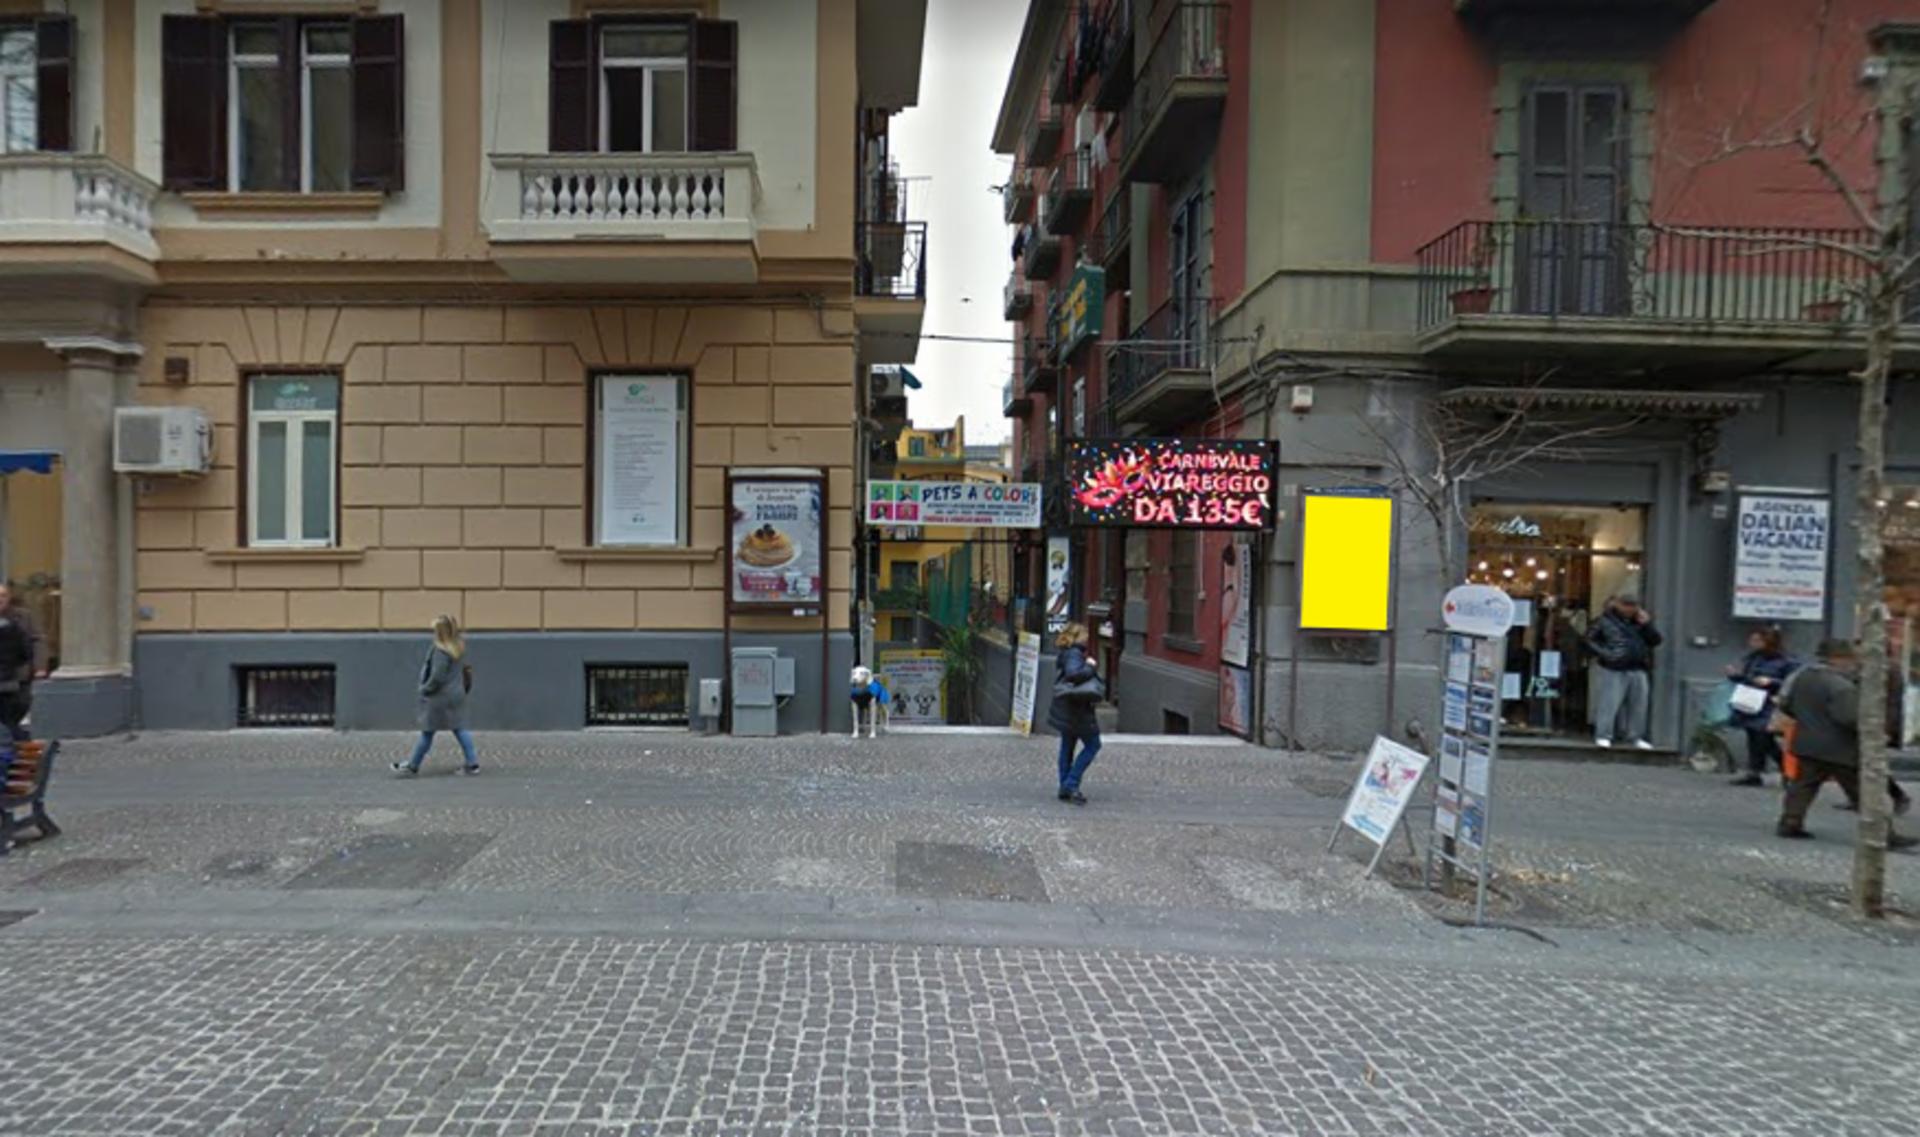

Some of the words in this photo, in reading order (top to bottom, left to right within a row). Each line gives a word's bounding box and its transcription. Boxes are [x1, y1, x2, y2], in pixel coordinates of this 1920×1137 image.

[1160, 452, 1261, 470] CARNEVALE
[1149, 474, 1270, 492] VIAREGGIO
[922, 484, 962, 502] PETS
[967, 485, 978, 500] A
[1134, 497, 1178, 523] DA
[1183, 497, 1263, 524] 135€
[1753, 501, 1816, 514] AGENZIA
[1742, 513, 1825, 532] DALIAN
[1742, 531, 1825, 551] VACANZE
